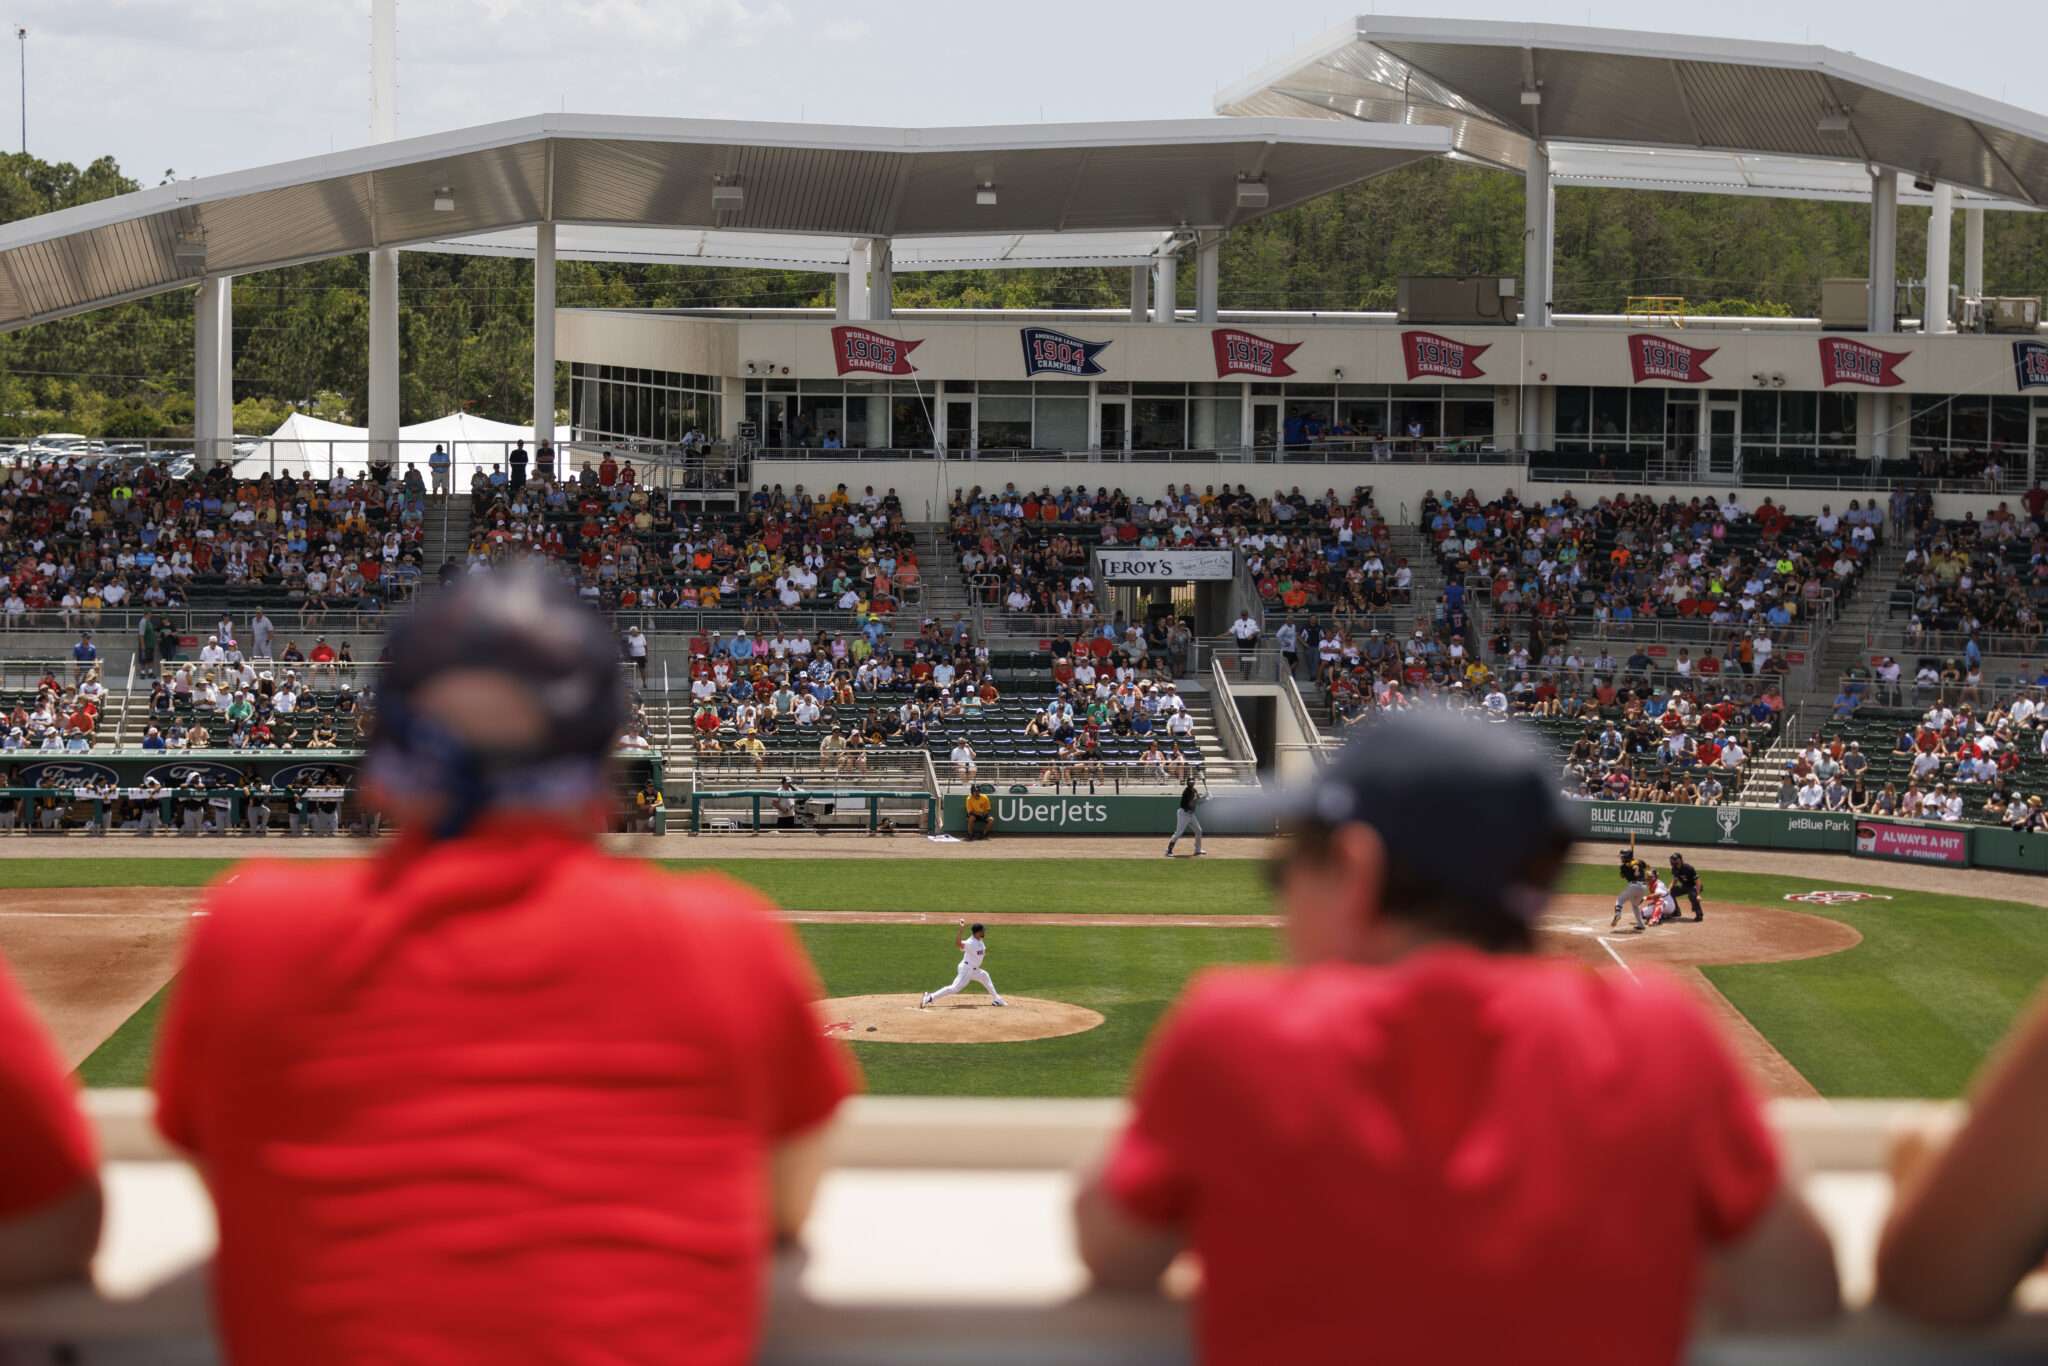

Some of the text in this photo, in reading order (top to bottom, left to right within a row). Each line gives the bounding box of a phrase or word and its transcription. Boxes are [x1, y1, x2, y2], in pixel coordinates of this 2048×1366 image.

[846, 332, 896, 347] WORLD SERIES
[1251, 339, 1275, 349] SERIES
[1416, 337, 1464, 351] WORLD SERIES
[1643, 340, 1691, 354] WORLD SERIES
[846, 339, 896, 366] 1903
[1034, 340, 1085, 367] 1904
[1228, 342, 1274, 367] 1912
[1833, 343, 1857, 352] WORLD
[1418, 344, 1463, 369] 1915
[1645, 347, 1690, 373] 1916
[1835, 349, 1882, 377] 1918
[849, 359, 894, 372] CHAMPIONS
[1038, 360, 1082, 373] CHAMPIONS
[1229, 361, 1272, 374] CHAMPIONS
[1419, 363, 1462, 376] CHAMPIONS
[1646, 366, 1689, 380] CHAMPIONS
[1836, 369, 1880, 384] CHAMPIONS
[1100, 559, 1173, 577] LEROY'S
[998, 798, 1108, 826] UberJets
[1591, 808, 1654, 824] BLUE LIZARD
[1788, 818, 1850, 831] jetBlue Park
[1882, 831, 1960, 849] ALWAYS A HIT
